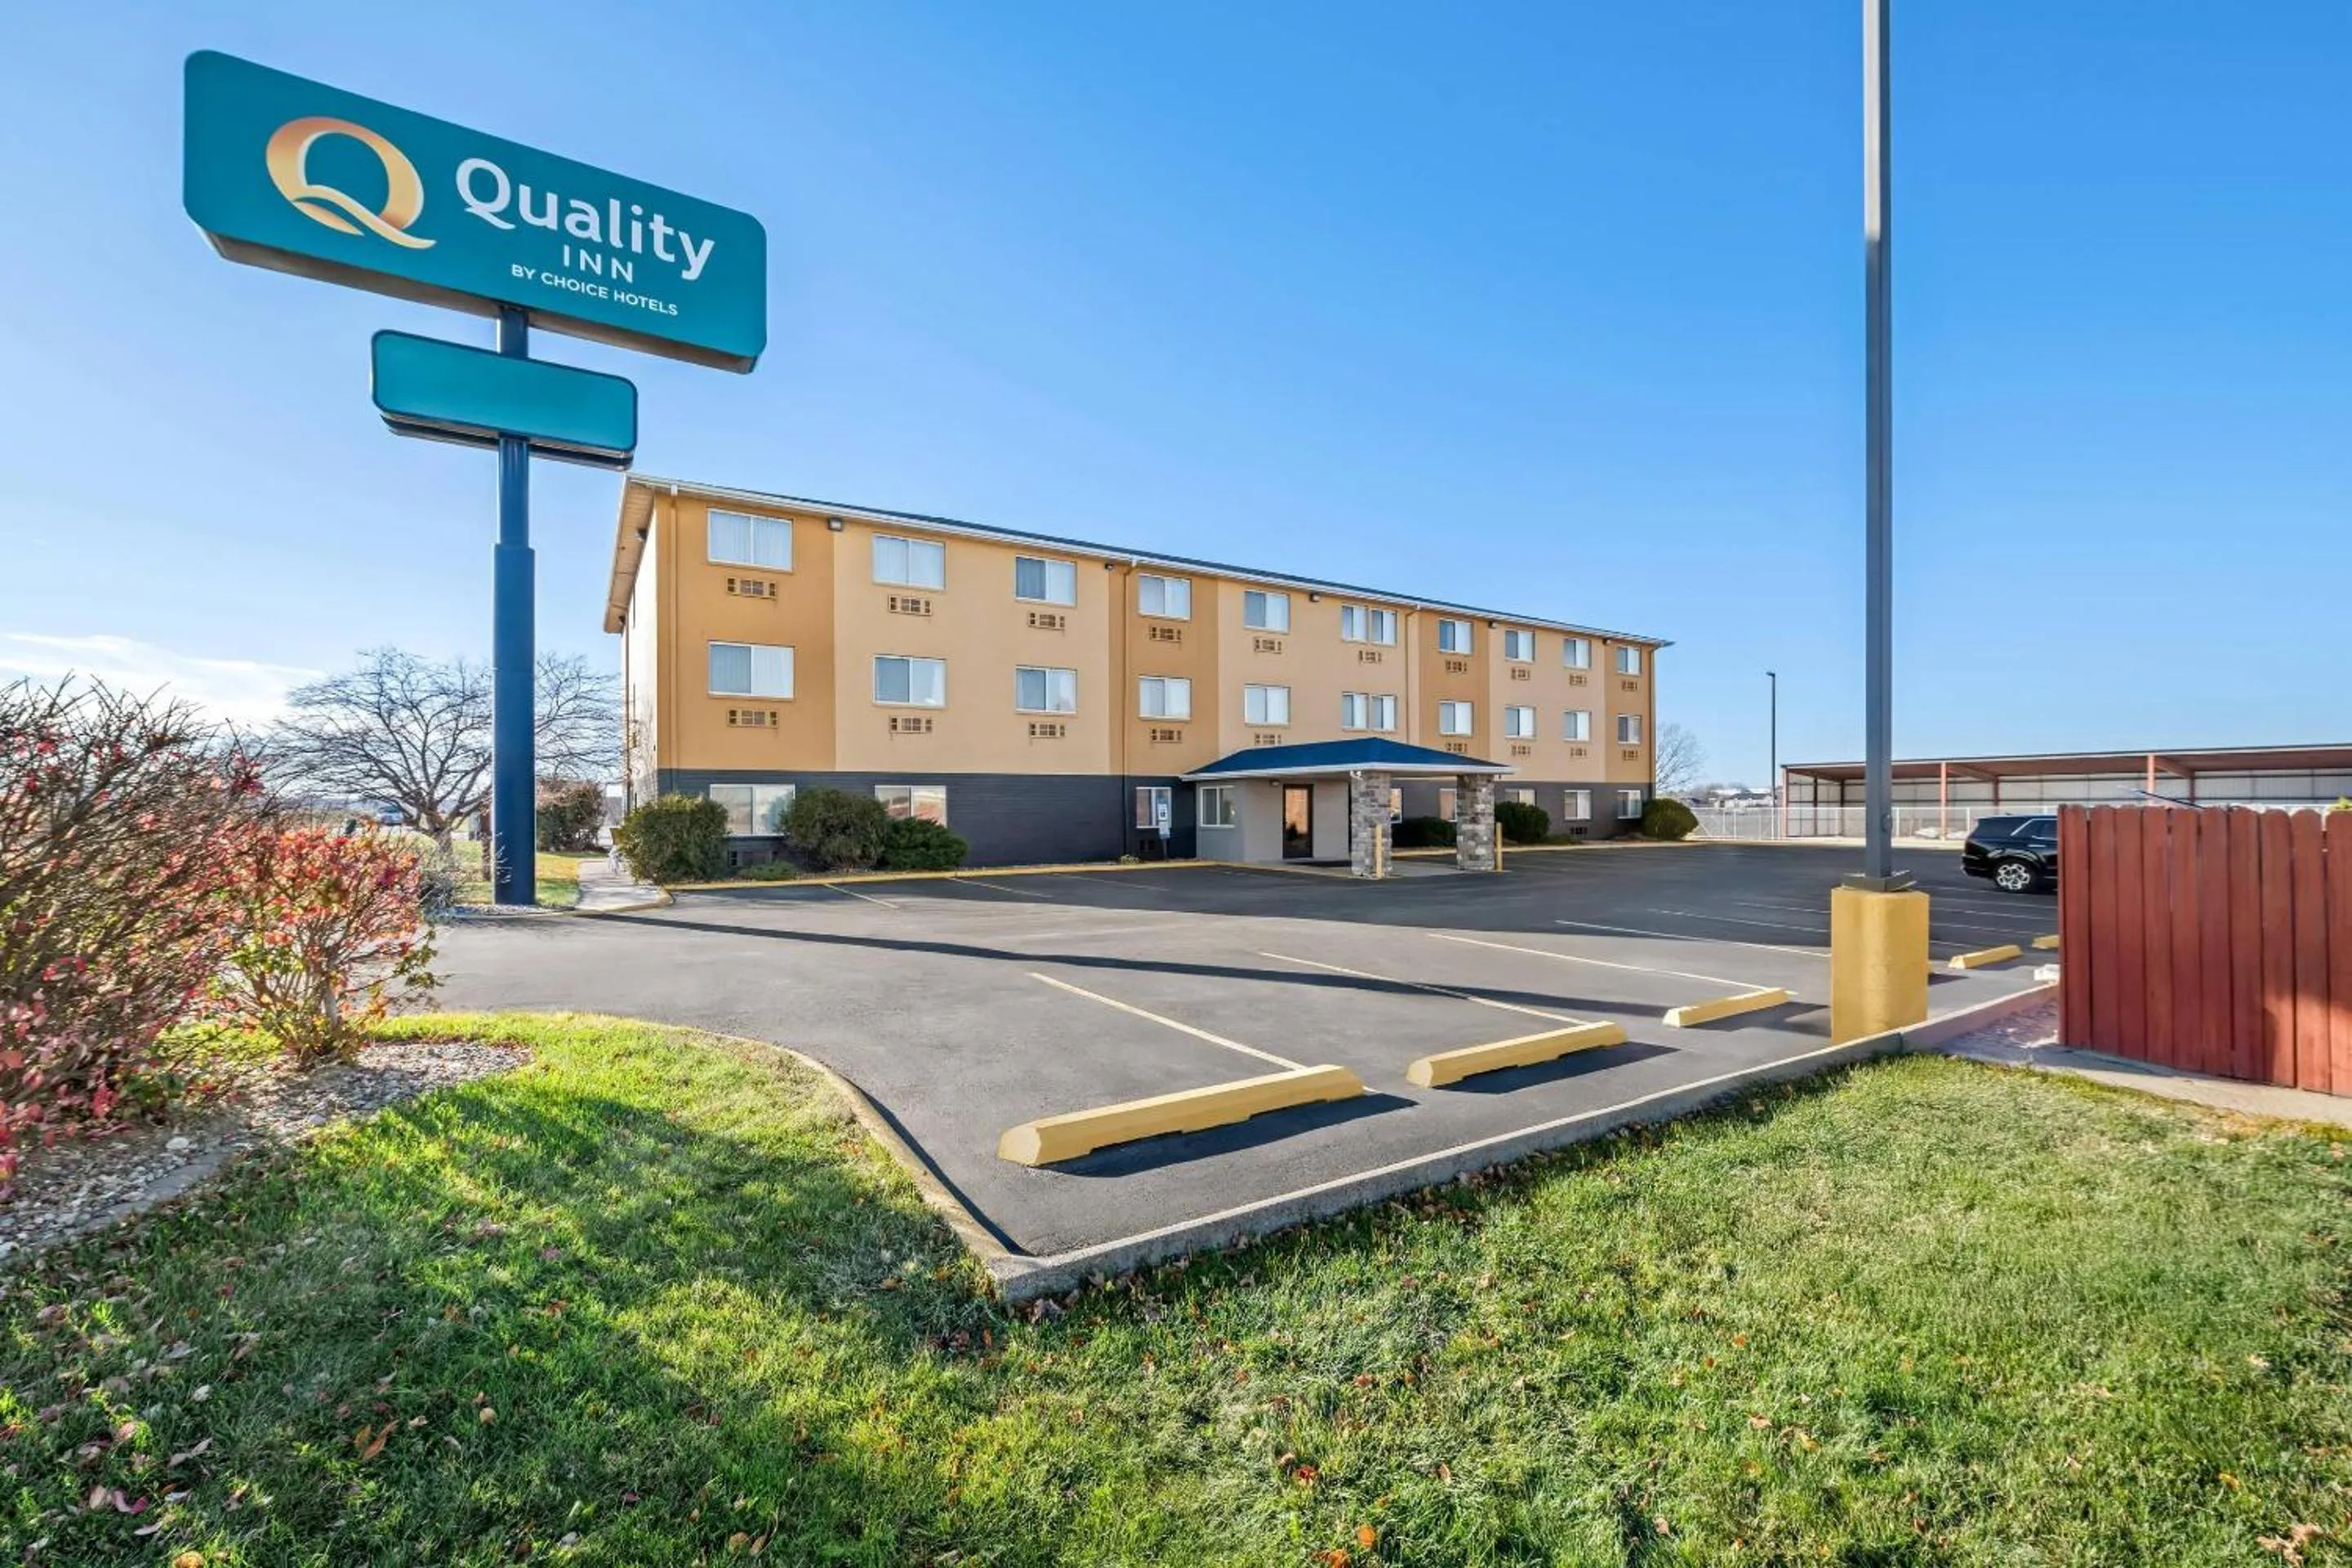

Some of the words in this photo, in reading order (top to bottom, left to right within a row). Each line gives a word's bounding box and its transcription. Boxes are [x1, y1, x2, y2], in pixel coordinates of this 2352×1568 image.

[265, 116, 438, 249] Q
[455, 157, 715, 281] Quality
[510, 263, 537, 279] BY
[541, 272, 608, 299] CHOICE
[613, 289, 679, 316] HOTELS
[563, 244, 634, 283] INN
